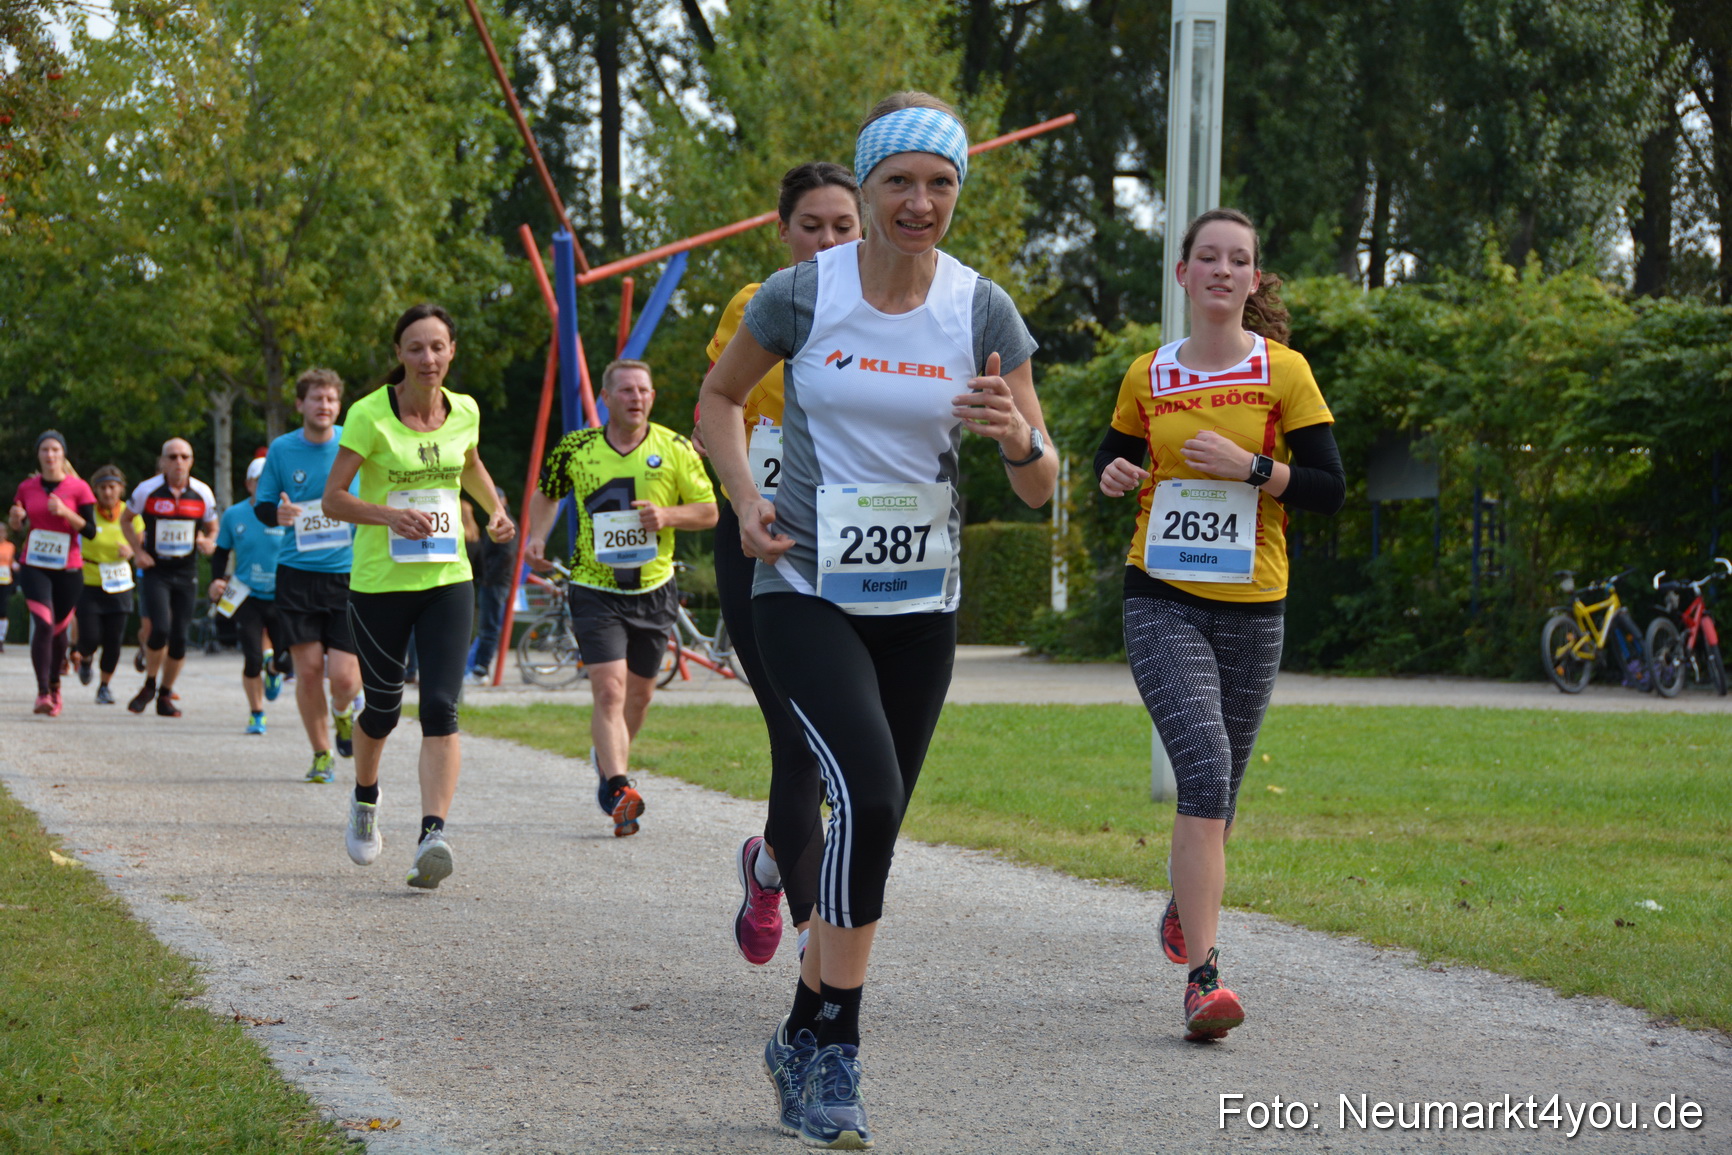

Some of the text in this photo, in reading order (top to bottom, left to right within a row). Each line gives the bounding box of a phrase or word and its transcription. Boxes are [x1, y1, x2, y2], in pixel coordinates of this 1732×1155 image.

[859, 357, 953, 381] KLEBL
[1154, 389, 1270, 417] MAX BÖGL
[871, 495, 918, 508] BOCK
[1190, 488, 1227, 500] BOCK
[1162, 510, 1239, 543] 2634
[161, 530, 187, 542] 2141
[603, 527, 648, 548] 2663
[33, 540, 62, 554] 2274
[839, 524, 932, 565] 2387
[1179, 551, 1218, 564] Sandra
[862, 577, 908, 592] Kerstin
